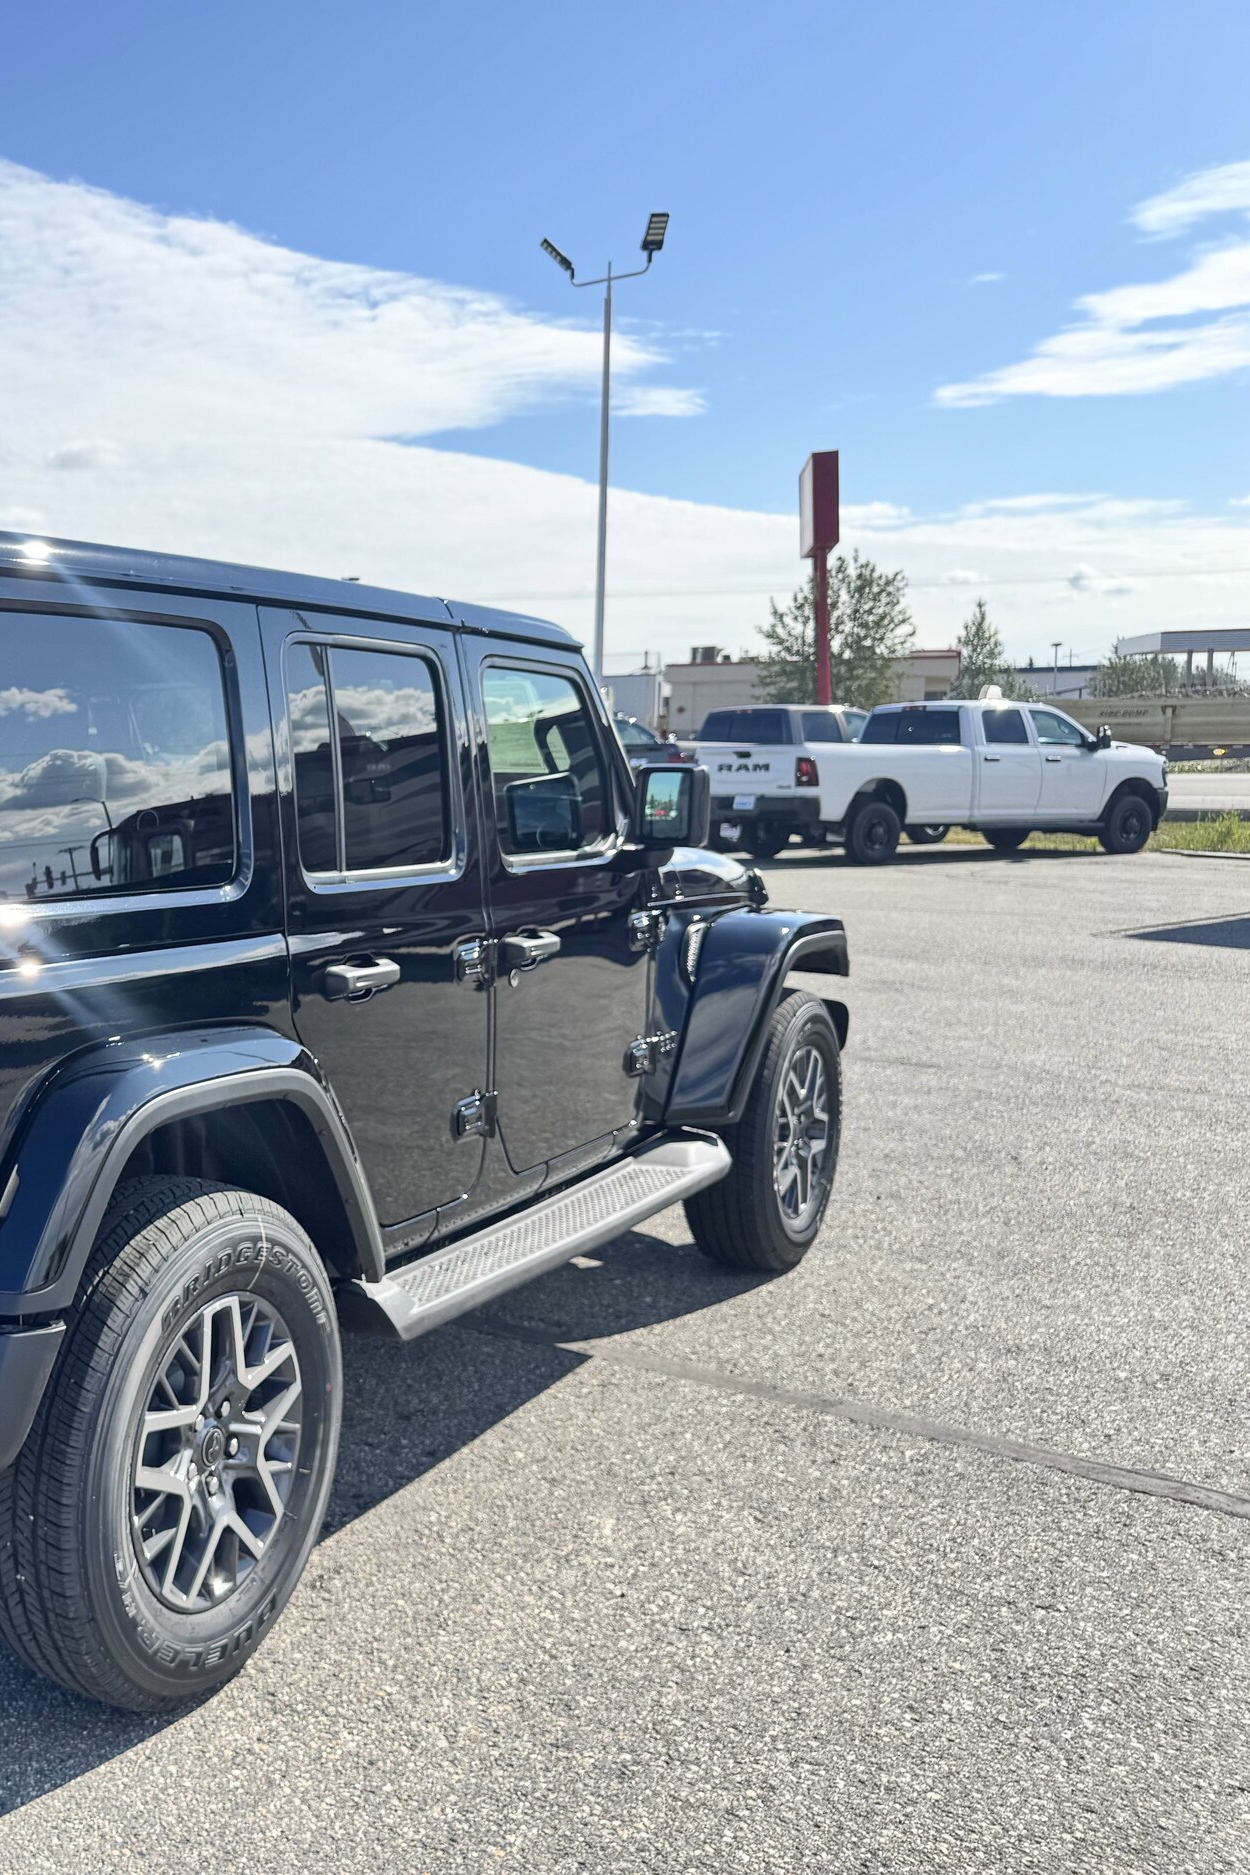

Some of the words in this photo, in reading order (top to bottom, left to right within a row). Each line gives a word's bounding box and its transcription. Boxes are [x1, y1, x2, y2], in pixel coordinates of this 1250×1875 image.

[717, 763, 770, 772] RAM
[161, 1240, 334, 1336] BRIDGESTONE
[137, 1588, 278, 1671] DUELER
